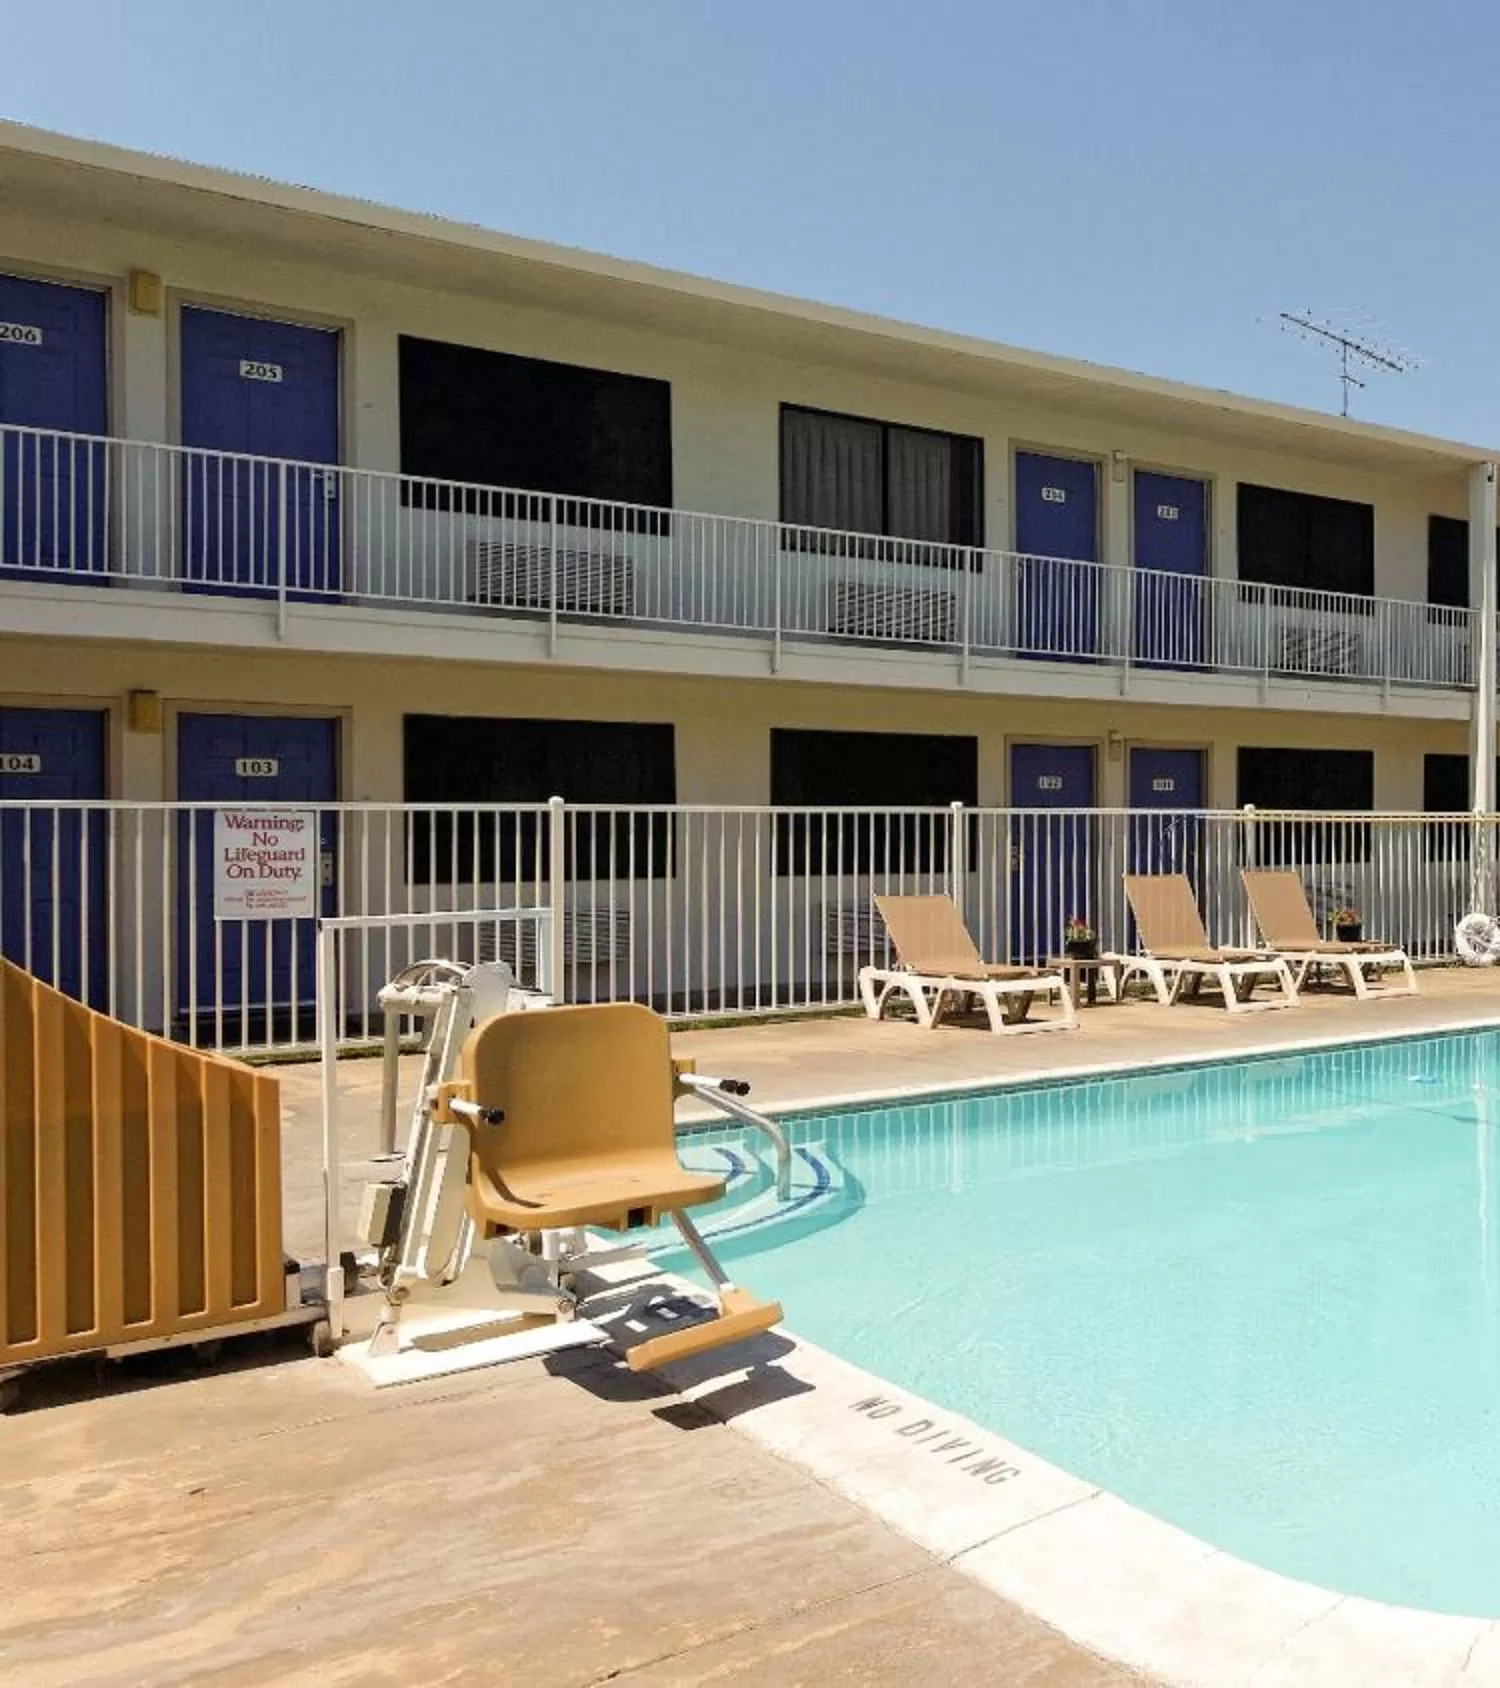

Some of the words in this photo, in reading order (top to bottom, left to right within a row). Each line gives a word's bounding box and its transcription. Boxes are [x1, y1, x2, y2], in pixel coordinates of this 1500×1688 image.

[0, 325, 37, 342] 206
[243, 363, 277, 379] 205
[241, 761, 273, 775] 103
[251, 831, 280, 847] No
[223, 847, 305, 865] Lifeguard
[226, 863, 255, 879] On
[848, 1395, 903, 1419] NO
[894, 1418, 1022, 1485] DIVING
